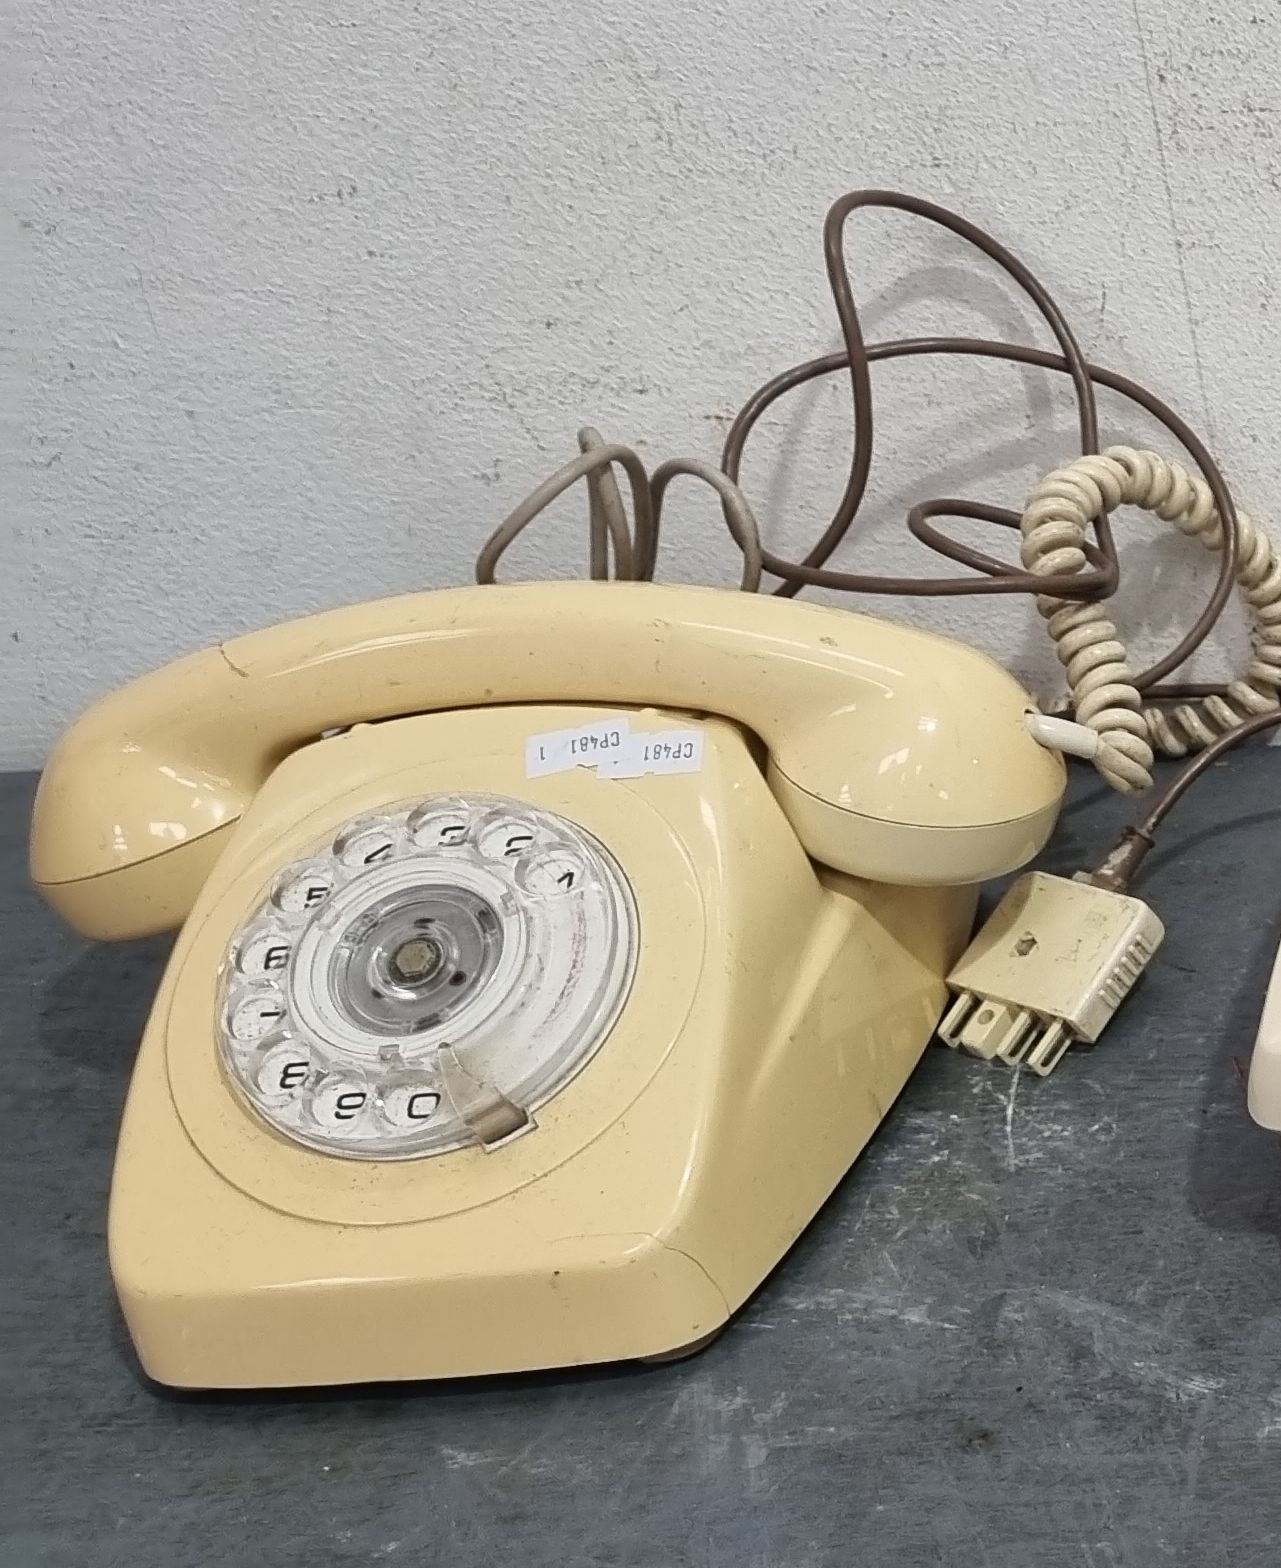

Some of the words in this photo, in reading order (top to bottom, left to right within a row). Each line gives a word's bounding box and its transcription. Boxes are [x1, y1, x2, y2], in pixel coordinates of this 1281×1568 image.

[571, 731, 620, 754] CP481
[643, 742, 694, 761] CP481
[334, 1092, 367, 1119] 9
[407, 1092, 441, 1119] 0
